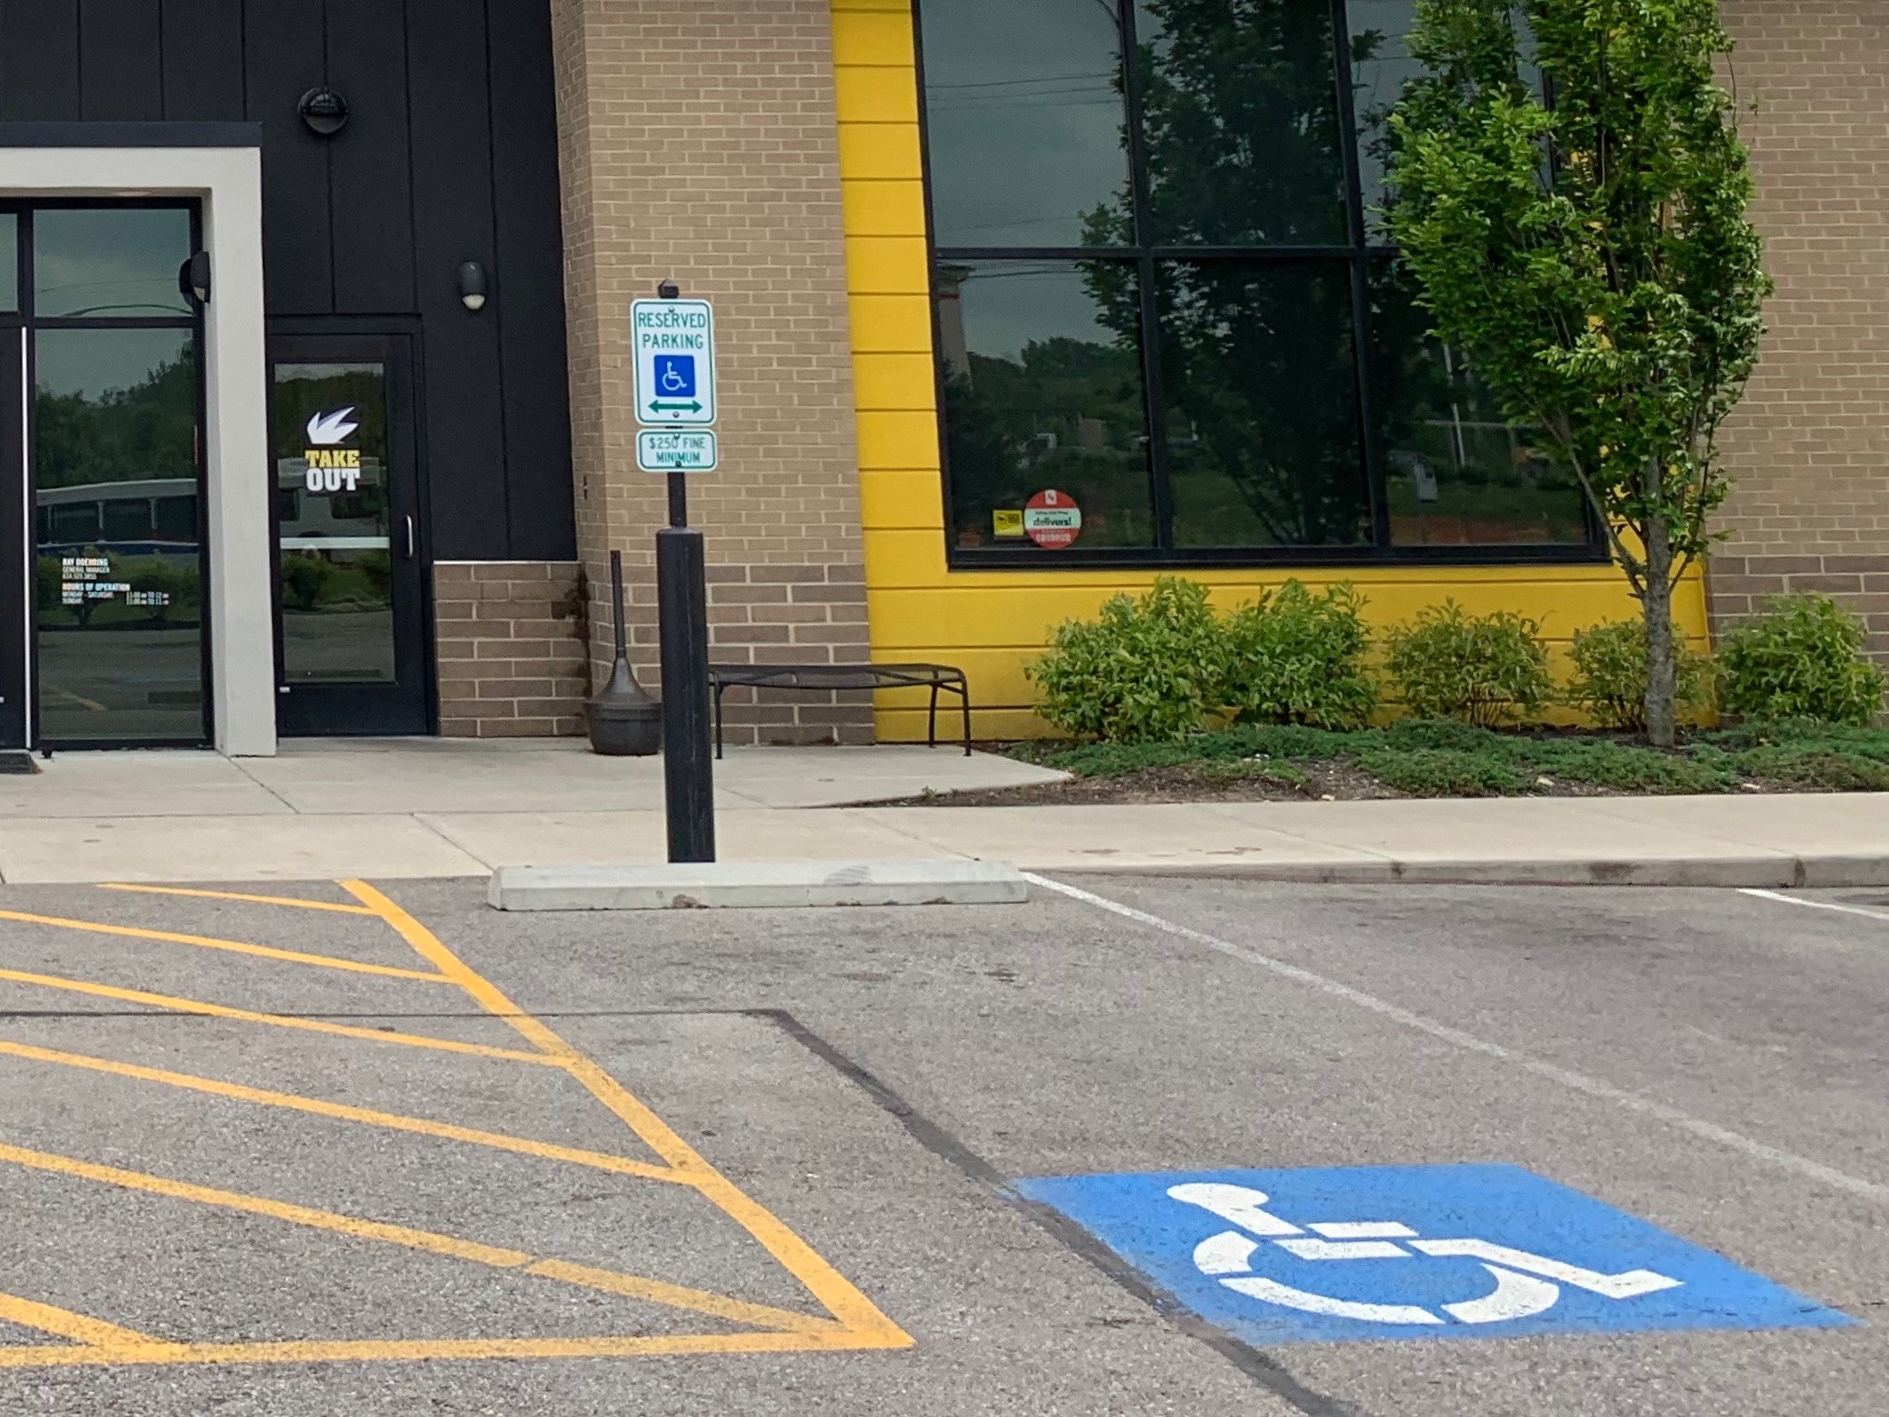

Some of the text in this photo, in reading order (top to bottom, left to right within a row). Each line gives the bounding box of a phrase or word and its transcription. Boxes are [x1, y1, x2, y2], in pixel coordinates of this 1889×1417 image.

[638, 312, 706, 328] RESERVED
[642, 333, 704, 350] PARKING
[649, 437, 706, 450] $250 FINE
[305, 450, 360, 468] TAKE
[656, 451, 700, 463] MINIMUM
[306, 468, 360, 491] OUT
[95, 583, 130, 591] OPERATION
